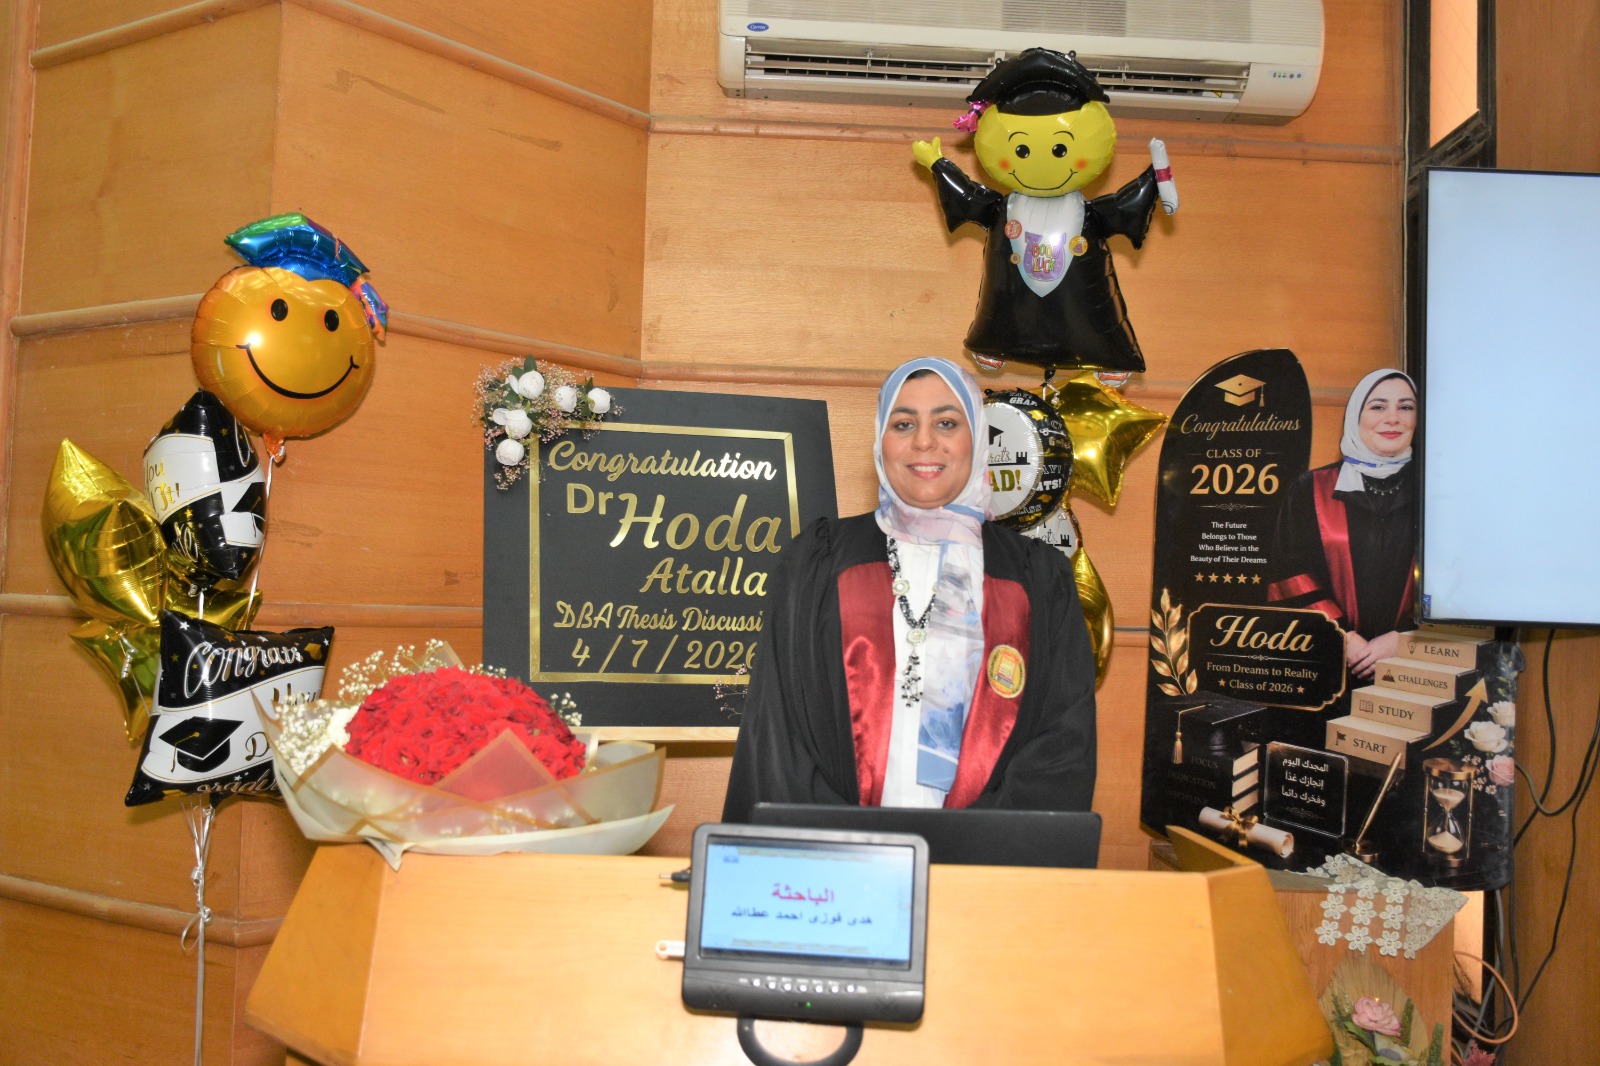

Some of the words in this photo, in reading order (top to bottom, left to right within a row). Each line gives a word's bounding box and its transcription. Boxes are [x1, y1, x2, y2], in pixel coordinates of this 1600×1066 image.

[1032, 244, 1060, 259] GOOD
[1033, 256, 1055, 273] LUCK
[1181, 412, 1301, 440] Congratulations
[548, 440, 777, 482] Congratulation
[988, 447, 1012, 463] rats
[1206, 448, 1242, 458] CLASS
[1246, 448, 1262, 458] OF
[988, 470, 1022, 492] AD!
[1190, 464, 1279, 494] 2026
[566, 482, 613, 514] Dr
[610, 493, 782, 554] Hoda
[1202, 533, 1227, 541] Belongs
[1190, 555, 1212, 563] Beauty
[640, 556, 768, 596] Atalla
[553, 600, 614, 629] DBA
[616, 604, 678, 630] Thesis
[682, 606, 764, 632] Discussi
[1210, 615, 1314, 652] Hoda
[1424, 645, 1460, 658] LEARN
[1206, 662, 1230, 672] From
[1233, 664, 1269, 675] Dreams
[1272, 666, 1282, 676] to
[1284, 668, 1318, 681] Reality
[1229, 680, 1254, 690] Class
[1256, 682, 1267, 691] of
[1269, 682, 1293, 693] 2026
[1398, 674, 1448, 690] CHALLENGES
[1378, 705, 1415, 720] STUDY
[1352, 738, 1387, 754] START
[1283, 758, 1300, 767] اليوم
[1299, 776, 1324, 790] إنجازك
[1300, 792, 1326, 807] وفخرك
[772, 882, 834, 906] الباحثة
